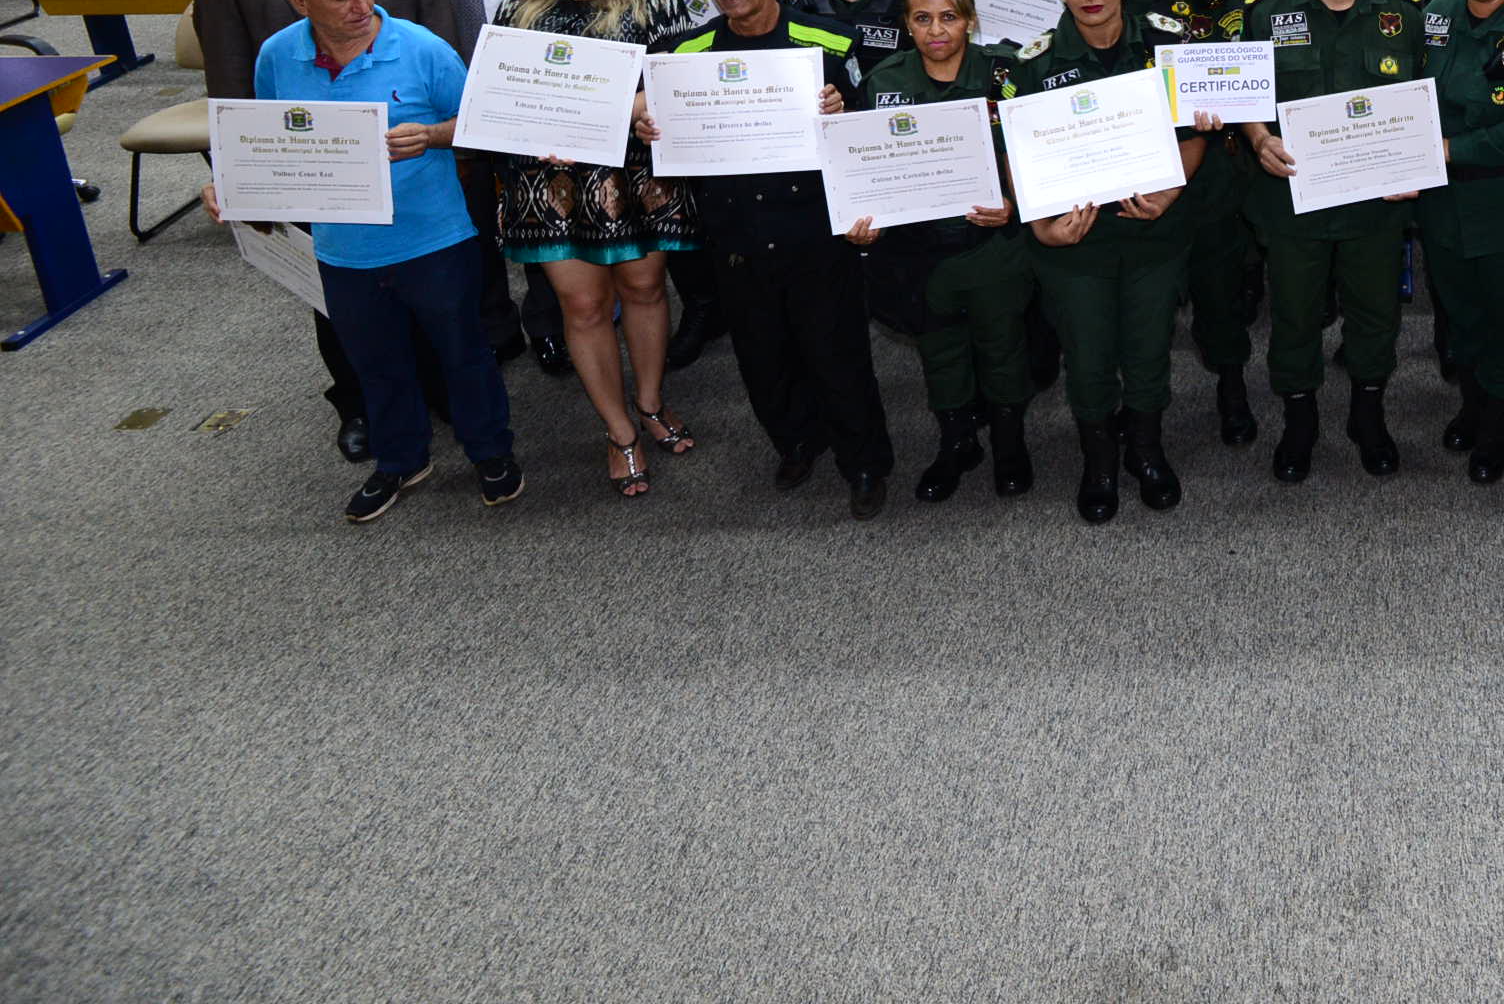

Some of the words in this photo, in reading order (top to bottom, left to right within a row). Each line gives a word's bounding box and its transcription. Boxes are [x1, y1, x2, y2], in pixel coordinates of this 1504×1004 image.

[1275, 13, 1304, 26] RAS
[1428, 16, 1448, 26] RAS
[863, 27, 894, 39] RAS
[1183, 48, 1213, 56] GRUPO
[1215, 46, 1263, 54] ECOLÓGICO
[1177, 55, 1226, 64] GUARDIÕES
[1242, 53, 1269, 61] VERDE
[1046, 71, 1078, 89] RAS
[1180, 79, 1270, 94] CERTIFICADO
[240, 135, 274, 146] Diploma
